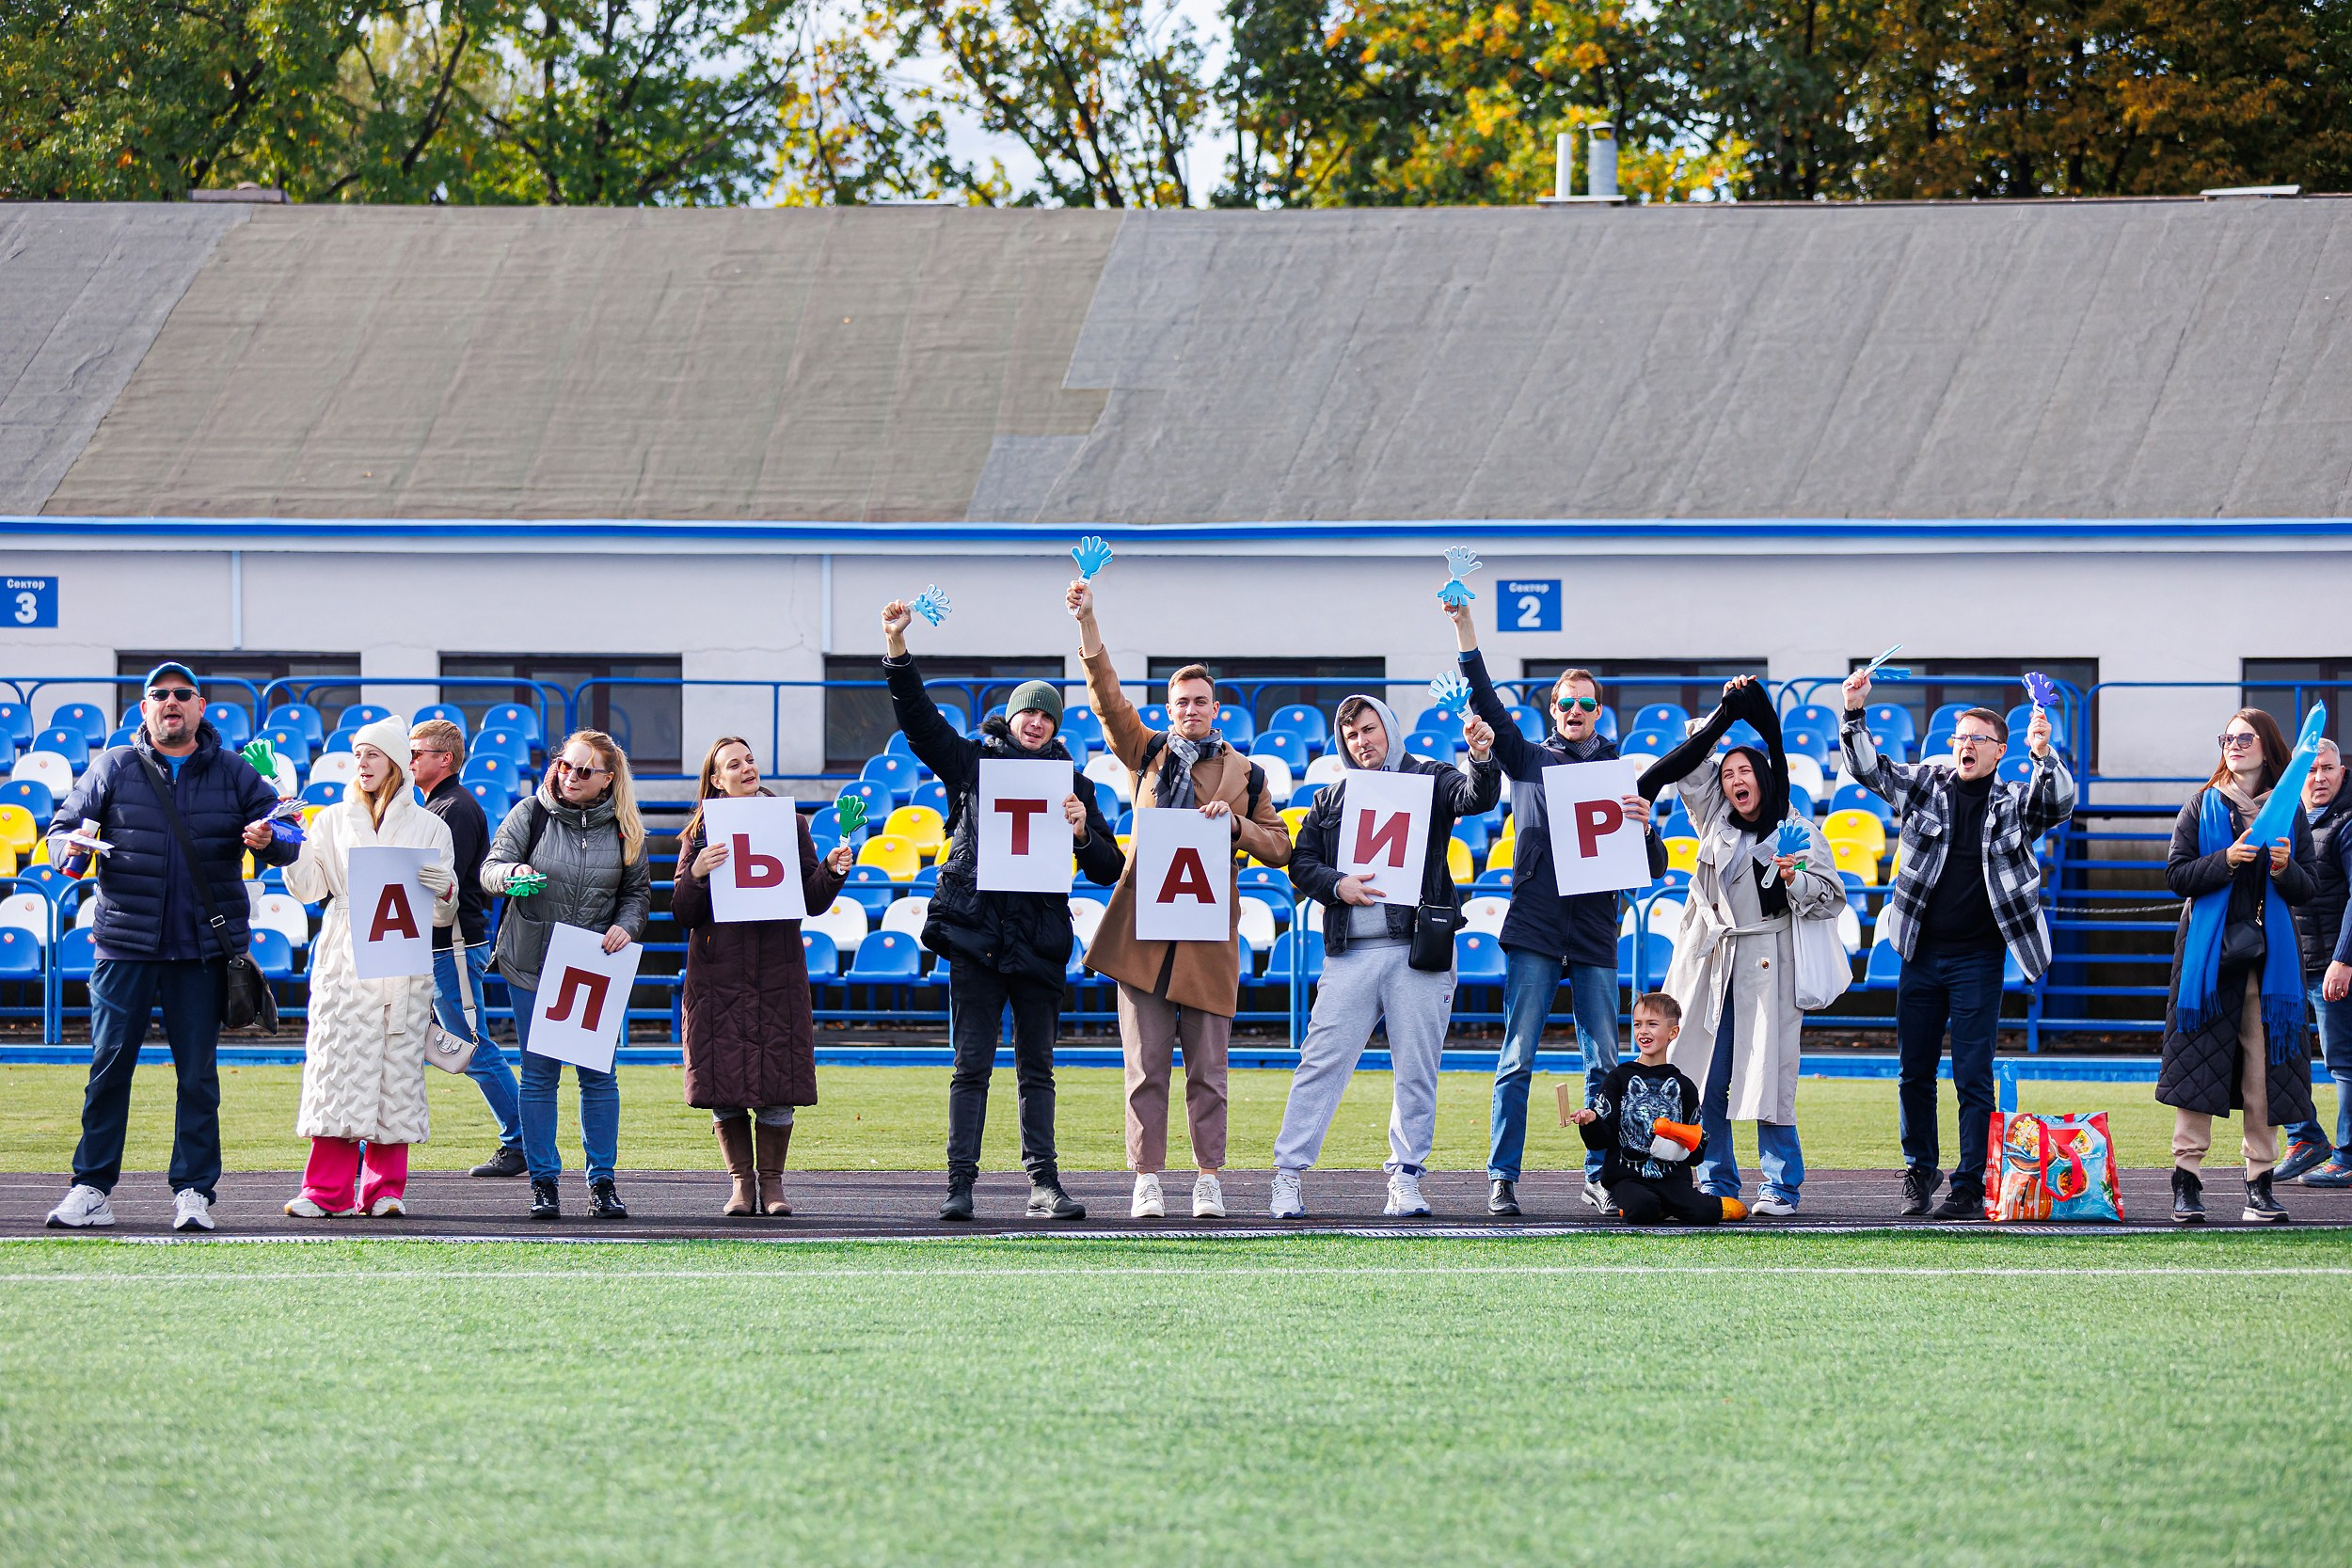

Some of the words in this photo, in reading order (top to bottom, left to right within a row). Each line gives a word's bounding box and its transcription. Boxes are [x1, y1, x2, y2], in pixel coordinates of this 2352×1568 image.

[7, 578, 46, 591] Сектор
[14, 592, 38, 625] 3
[1517, 594, 1542, 628] 2
[994, 799, 1047, 855] Т
[1354, 810, 1410, 867] И
[1574, 800, 1624, 857] Р
[732, 833, 785, 889] Ь
[1156, 847, 1216, 904] А
[369, 884, 420, 942] А
[545, 966, 612, 1032] Л
